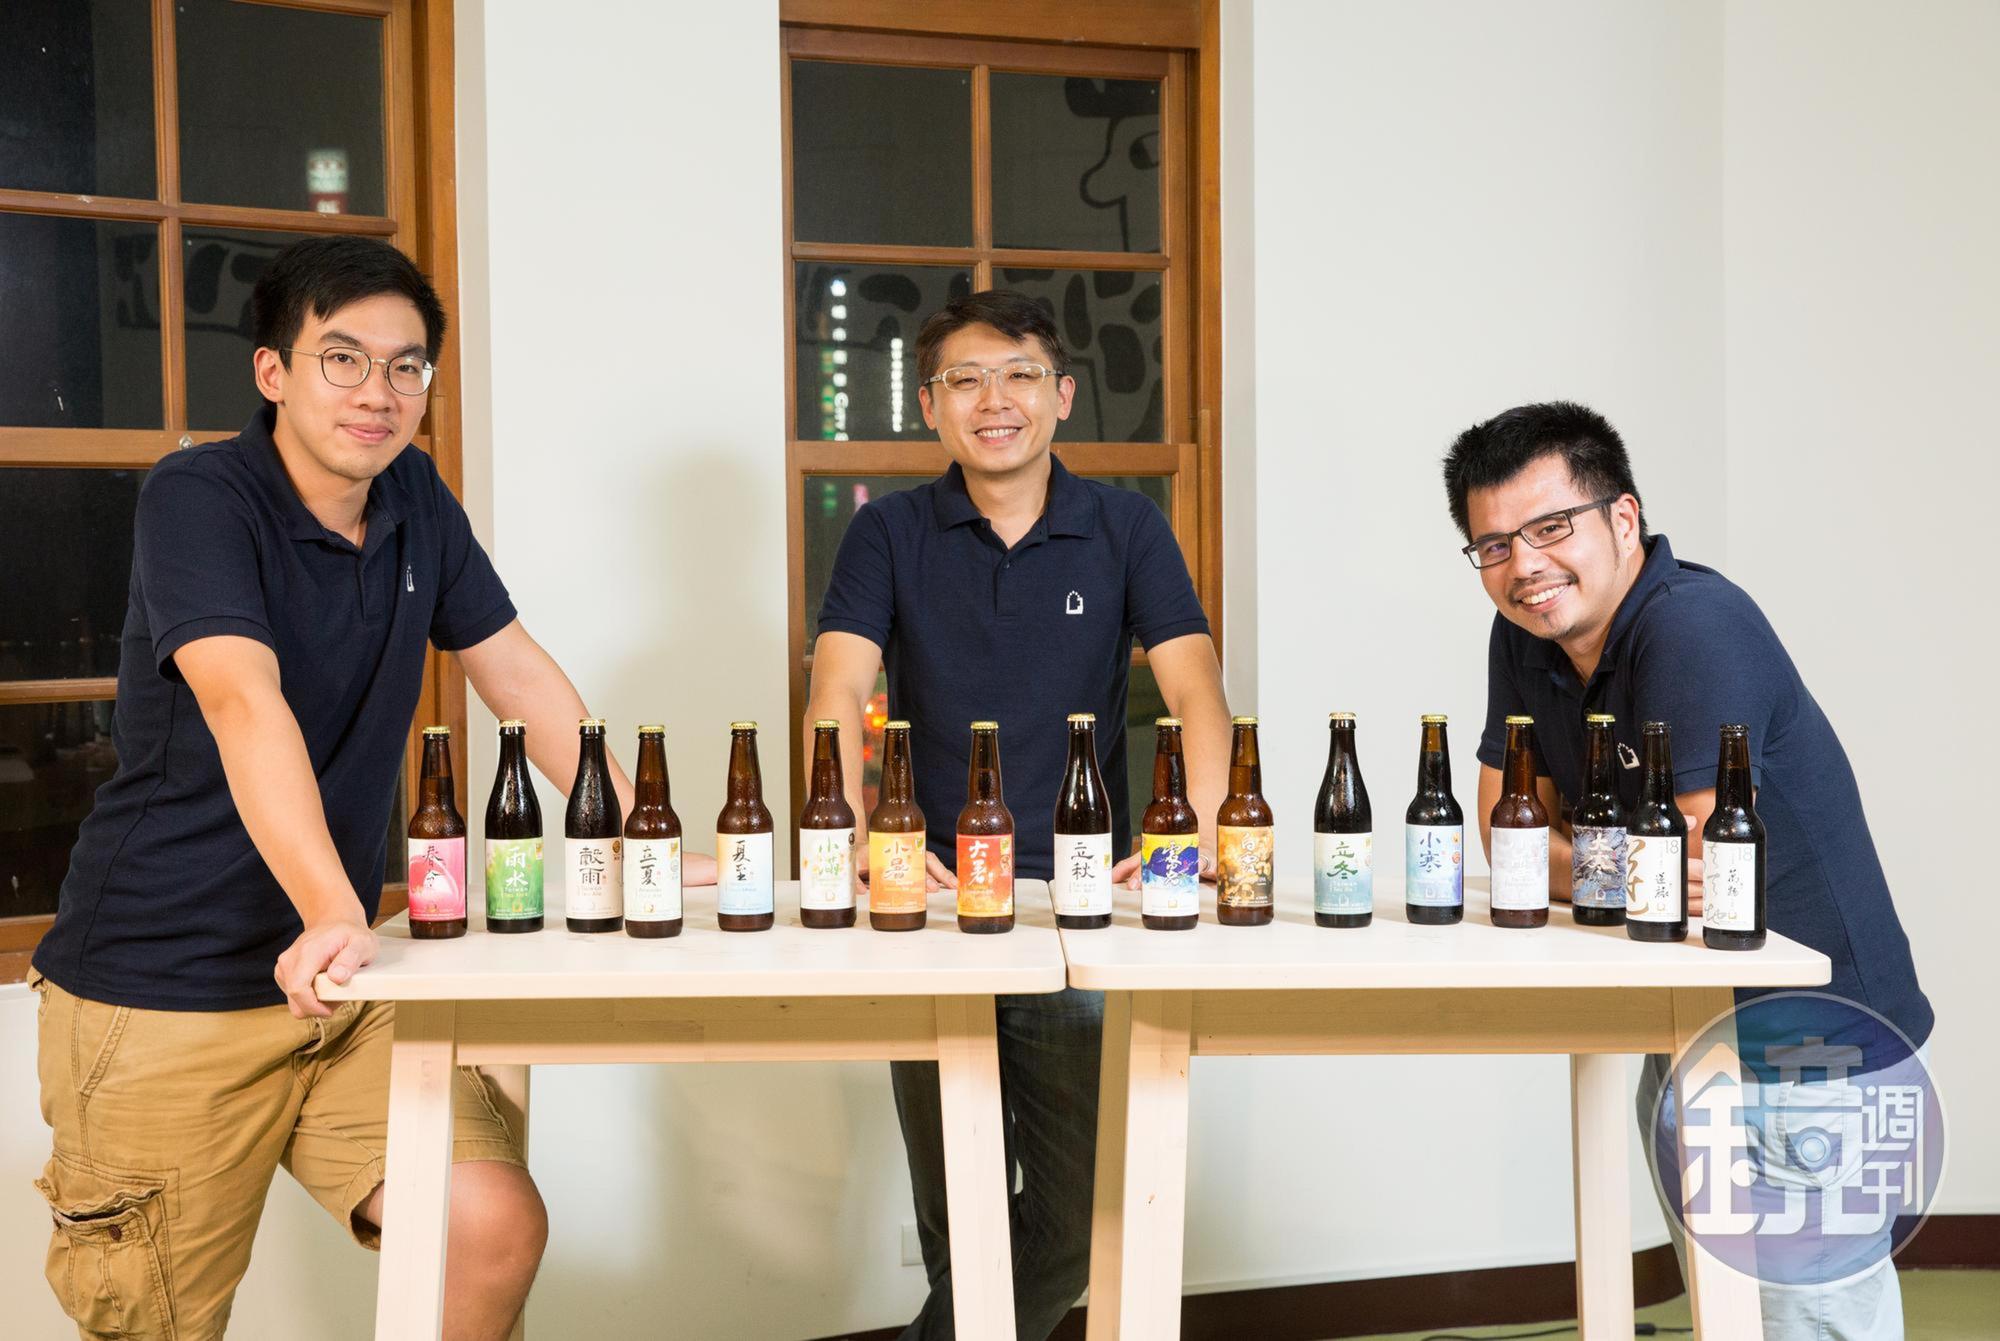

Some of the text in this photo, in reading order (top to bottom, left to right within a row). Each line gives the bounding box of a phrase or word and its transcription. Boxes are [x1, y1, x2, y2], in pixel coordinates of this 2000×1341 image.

[504, 846, 529, 887] 雨水
[638, 844, 660, 887] 立夏
[731, 839, 751, 881] 夏至
[883, 840, 910, 881] 小暑
[968, 839, 990, 886] 大暑
[1070, 841, 1096, 880] 立秋
[1326, 841, 1358, 880] 立冬
[1419, 831, 1442, 873] 小寒
[1665, 839, 1680, 855] 18
[1737, 846, 1753, 862] 18
